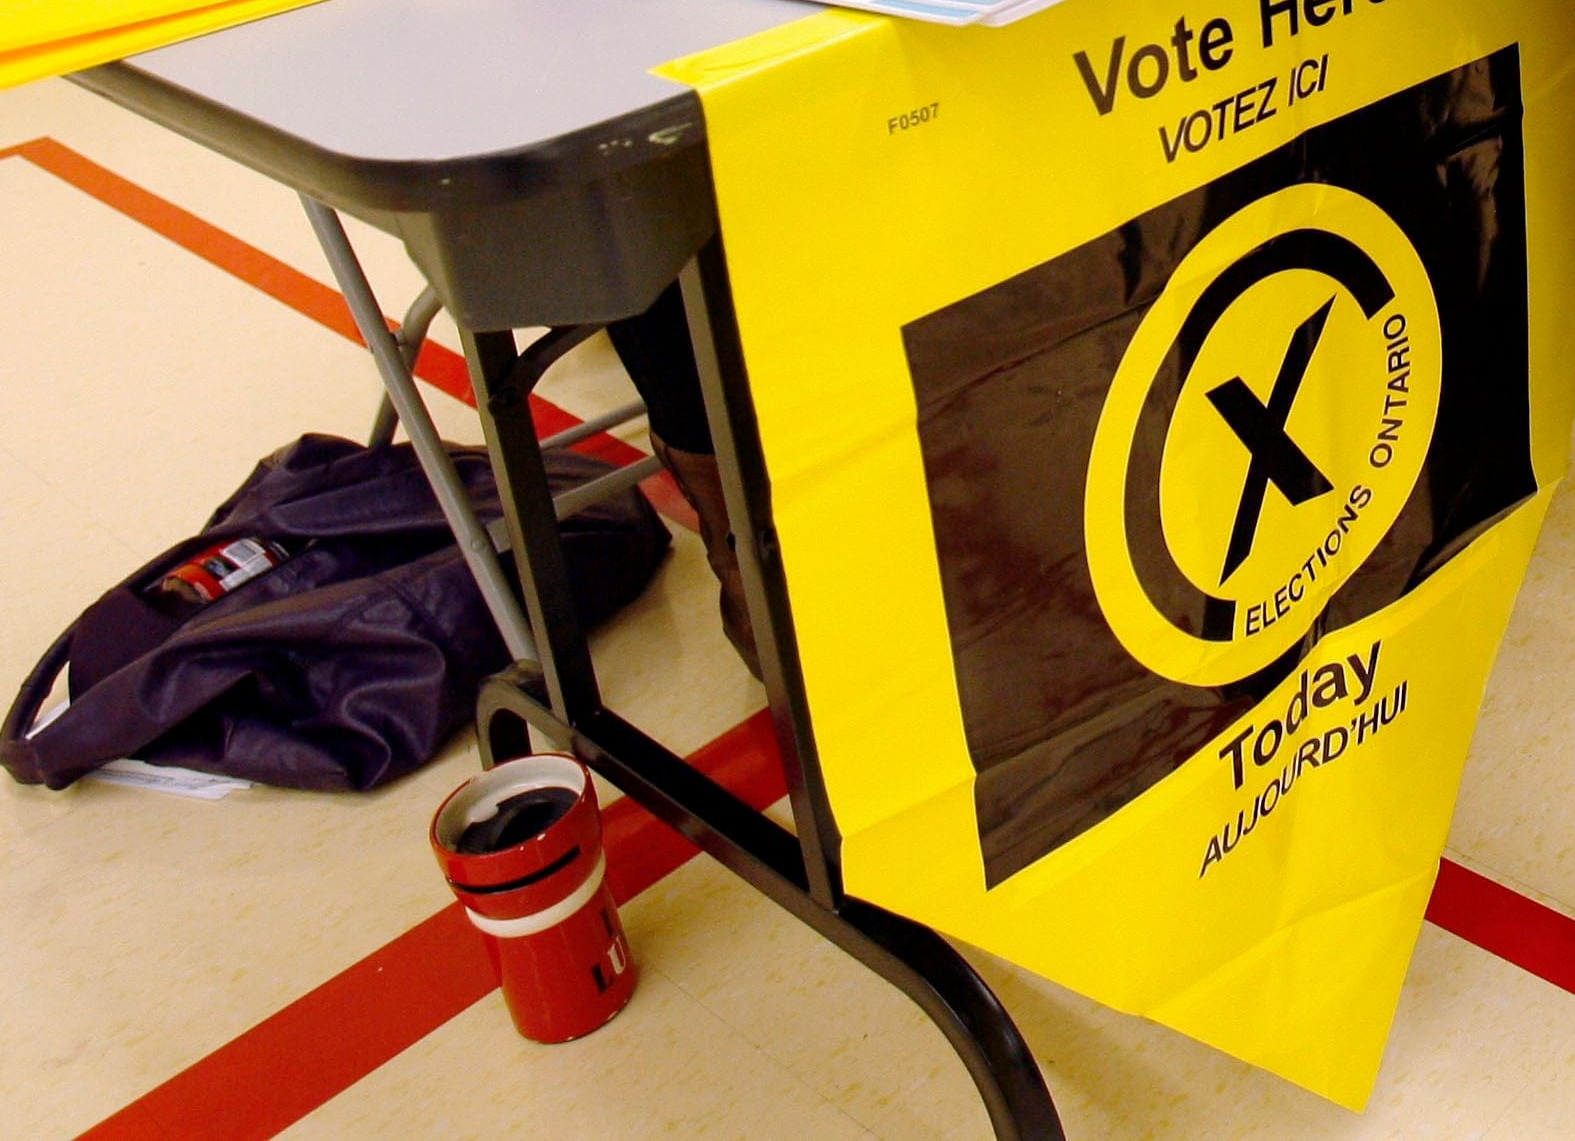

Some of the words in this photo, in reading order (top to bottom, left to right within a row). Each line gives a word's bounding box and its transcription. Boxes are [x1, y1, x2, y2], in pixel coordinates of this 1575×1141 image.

[887, 102, 939, 135] F0507
[1072, 15, 1234, 117] Vote
[1158, 76, 1278, 164] VOTEZ
[1287, 54, 1330, 108] ICI
[1246, 484, 1372, 638] ELECTIONS
[1369, 313, 1411, 469] ONTARIO
[1199, 680, 1408, 880] AUJOURD'HUI
[1218, 639, 1382, 791] Today
